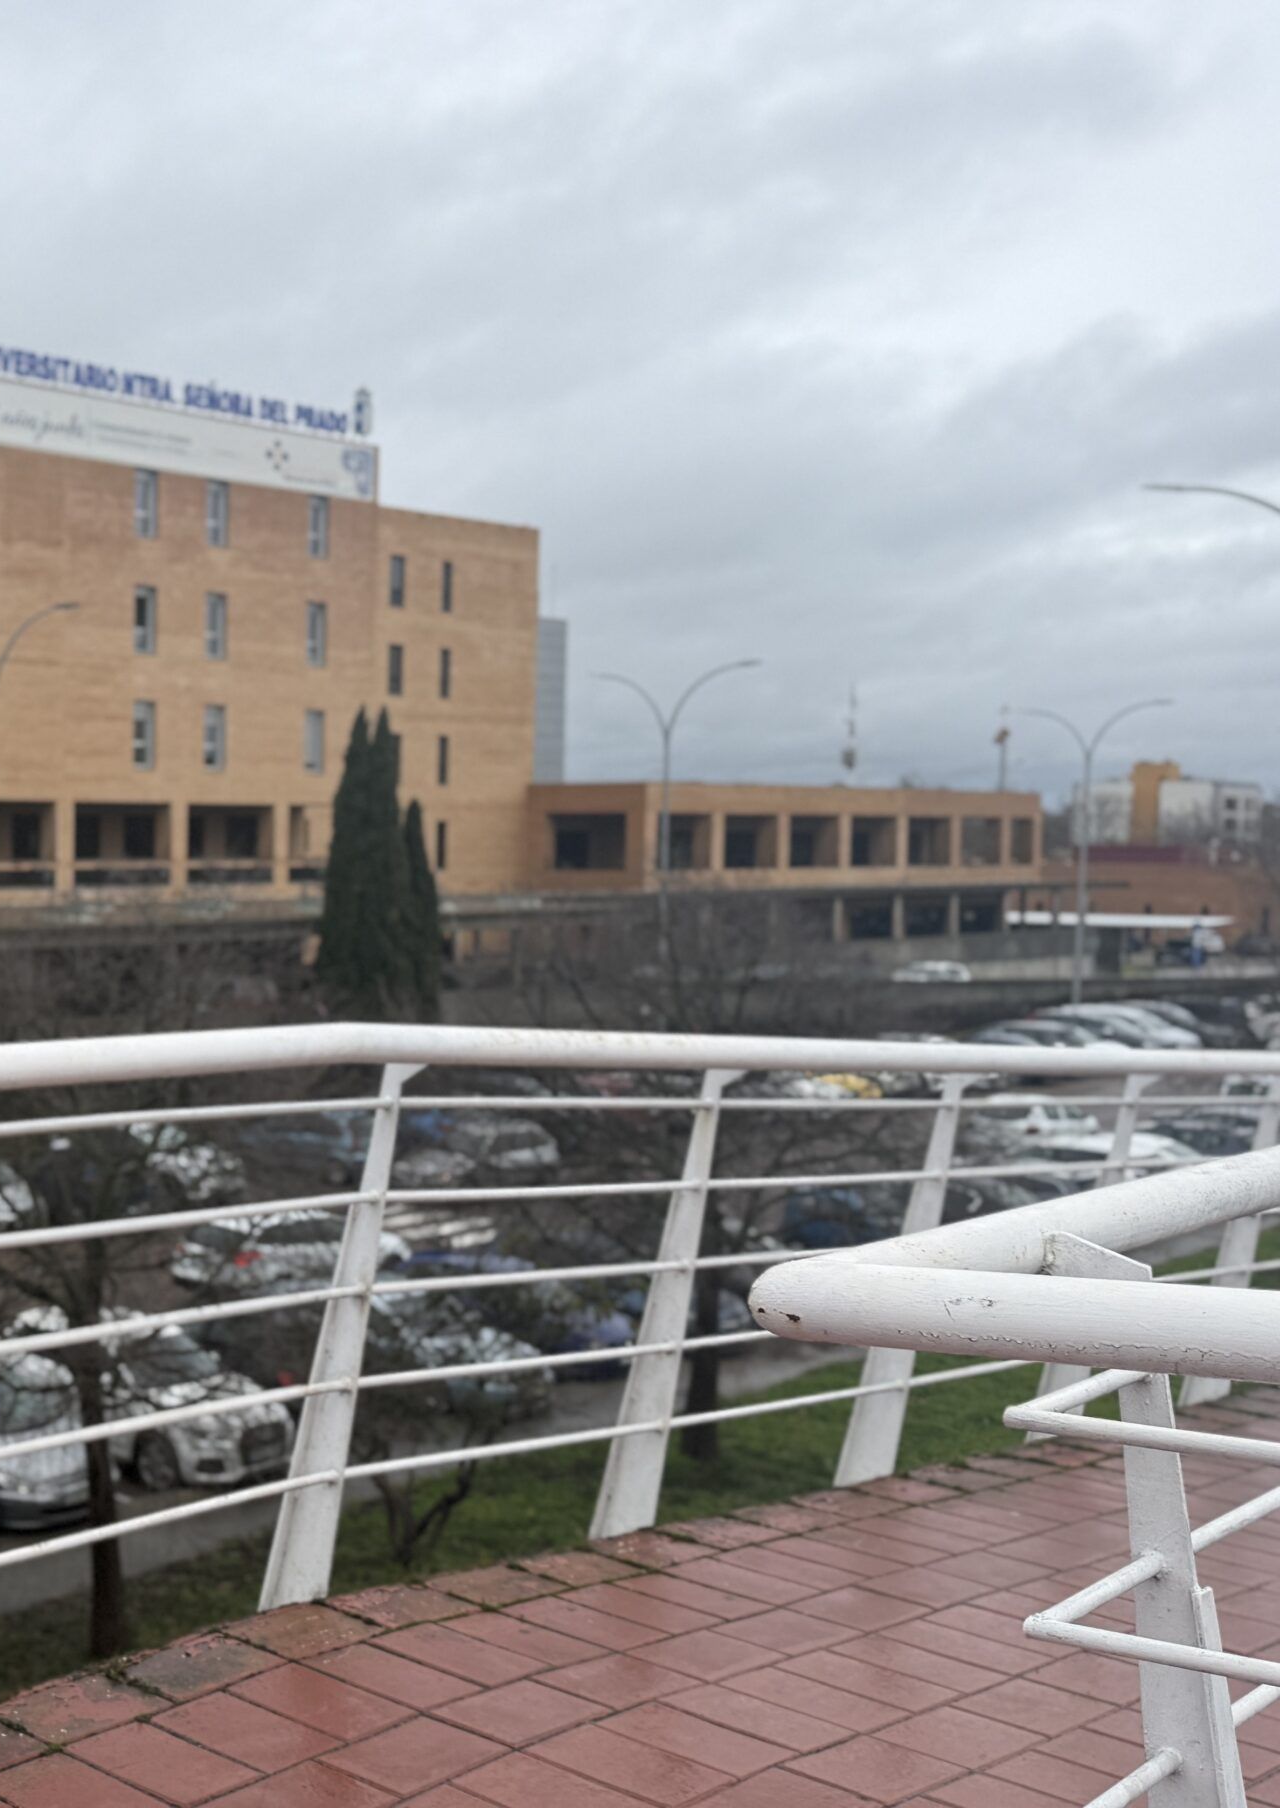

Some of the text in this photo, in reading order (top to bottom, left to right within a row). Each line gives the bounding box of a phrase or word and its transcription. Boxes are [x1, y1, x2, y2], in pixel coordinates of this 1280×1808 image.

[184, 379, 253, 418] SEÑORA
[260, 397, 288, 424] DEL
[294, 403, 348, 434] PRADO
